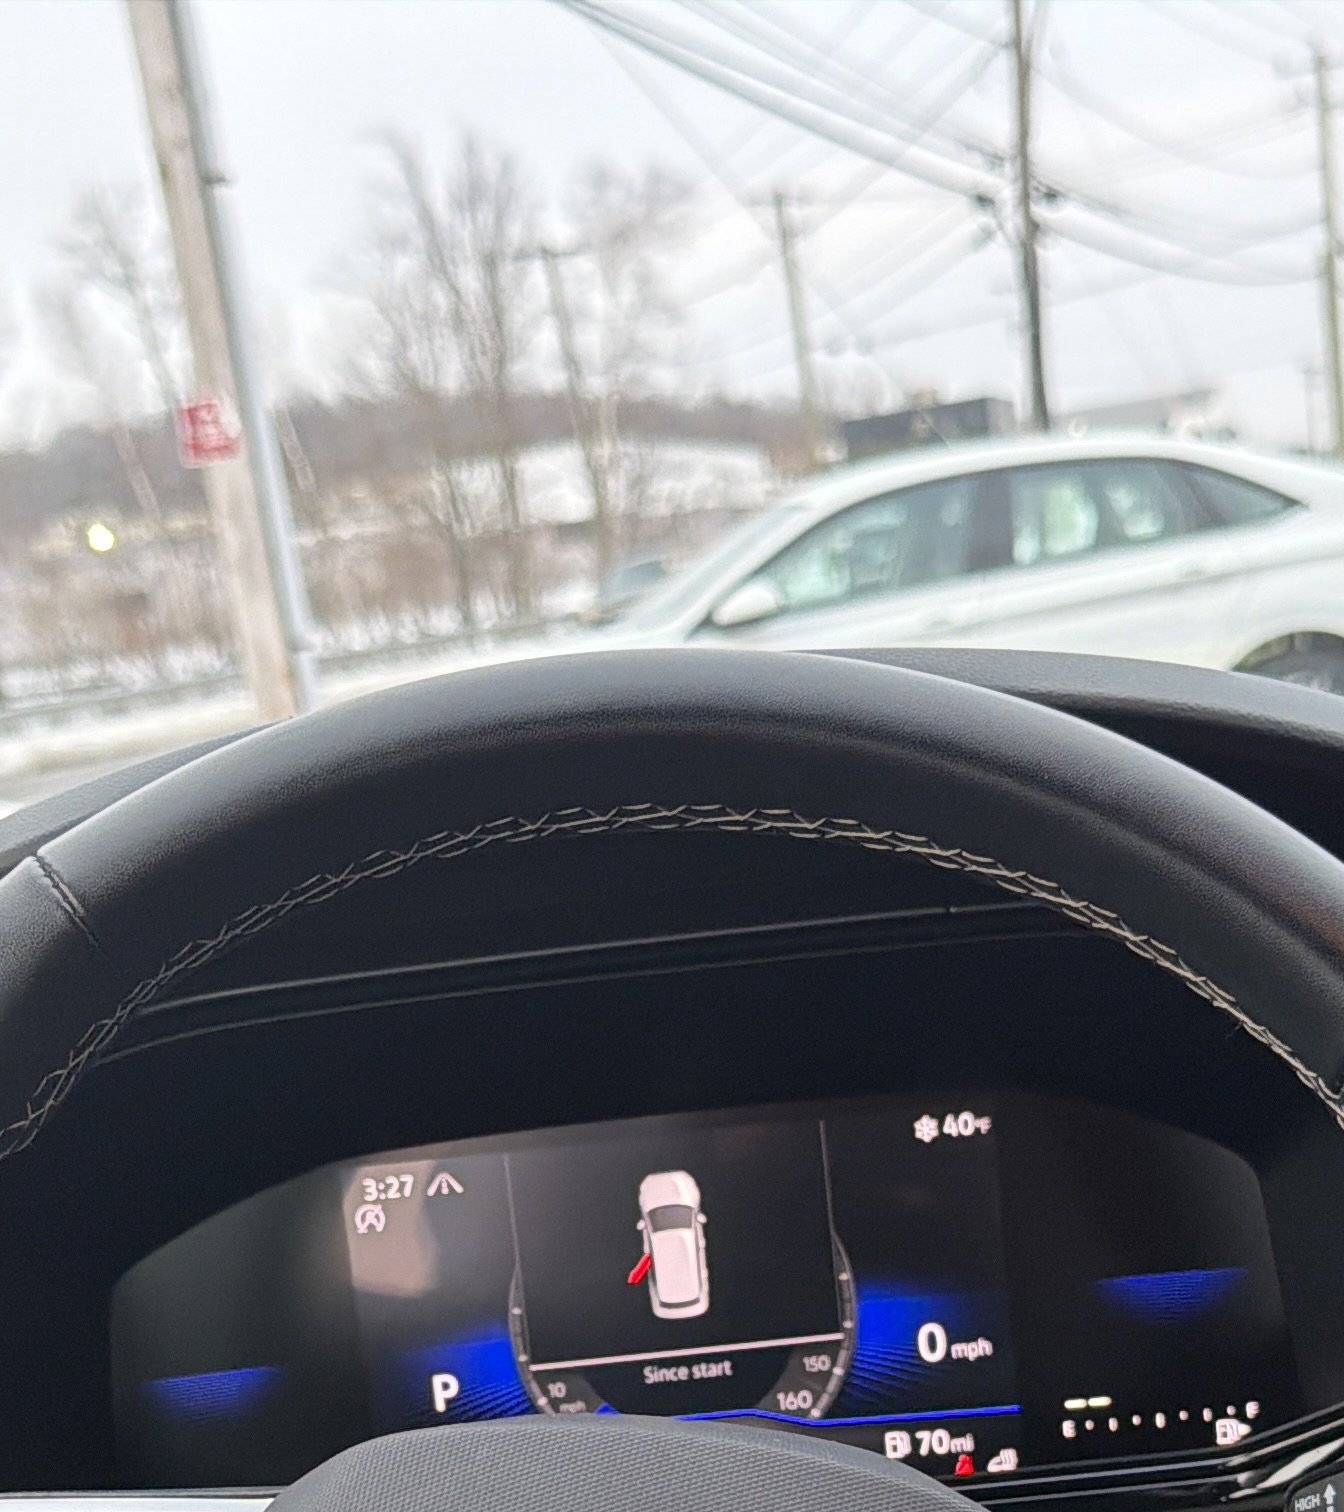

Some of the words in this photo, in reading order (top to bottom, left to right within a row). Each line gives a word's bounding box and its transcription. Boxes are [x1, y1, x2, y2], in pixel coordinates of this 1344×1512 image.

[362, 1174, 415, 1201] 3:27
[917, 1321, 948, 1363] 0
[950, 1337, 993, 1361] mph
[642, 1364, 689, 1385] Since
[691, 1359, 733, 1379] start
[802, 1354, 831, 1373] 150
[431, 1372, 459, 1413] P
[547, 1381, 567, 1398] 10
[776, 1389, 813, 1411] 160
[1294, 1493, 1321, 1512] HIGH
